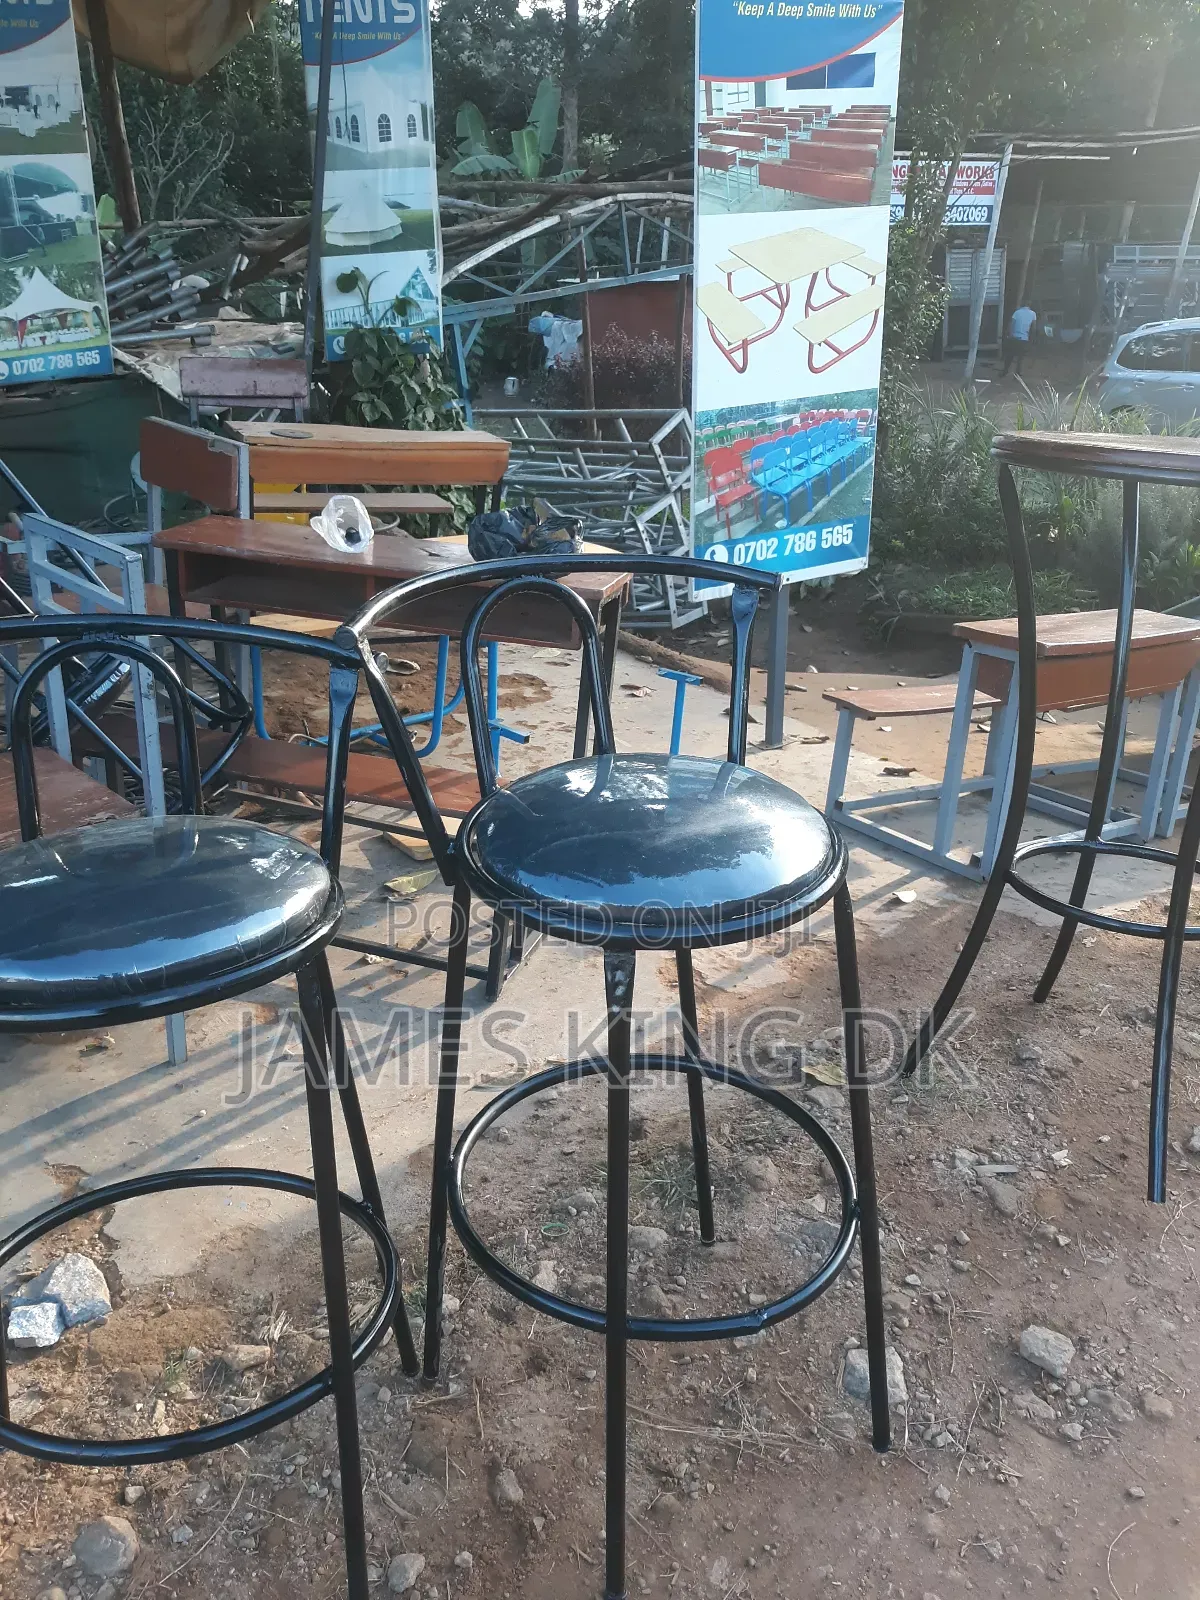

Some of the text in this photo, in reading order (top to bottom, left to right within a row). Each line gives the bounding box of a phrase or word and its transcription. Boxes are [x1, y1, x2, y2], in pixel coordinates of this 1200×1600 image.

[733, 1, 883, 19] "Keep A Deep Smile With Us"
[332, 32, 338, 40] A
[357, 32, 376, 40] Smile
[377, 32, 392, 40] With
[956, 166, 994, 179] WORKS
[12, 349, 101, 375] 0702 786 565
[733, 523, 854, 565] 0702 786 565
